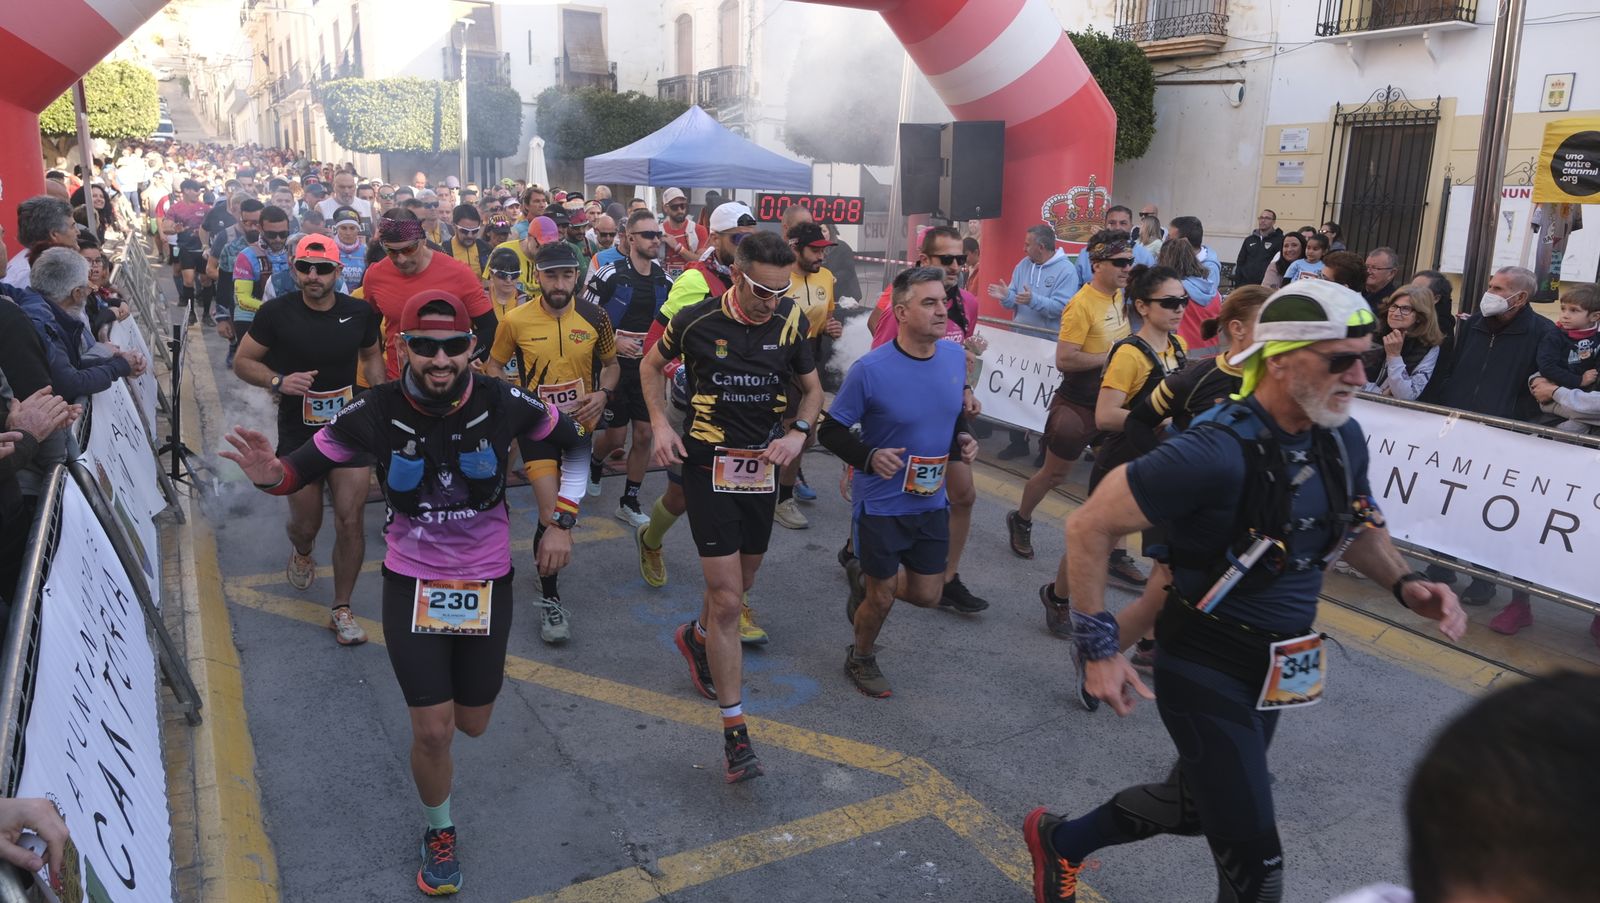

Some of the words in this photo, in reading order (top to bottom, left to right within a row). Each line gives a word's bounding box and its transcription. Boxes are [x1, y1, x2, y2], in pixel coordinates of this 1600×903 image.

[1560, 175, 1578, 185] .org
[712, 372, 779, 386] Cantoria
[547, 389, 578, 404] 103
[722, 391, 771, 403] Runners
[312, 397, 344, 411] 311
[733, 458, 759, 473] 70
[429, 591, 479, 611] 230
